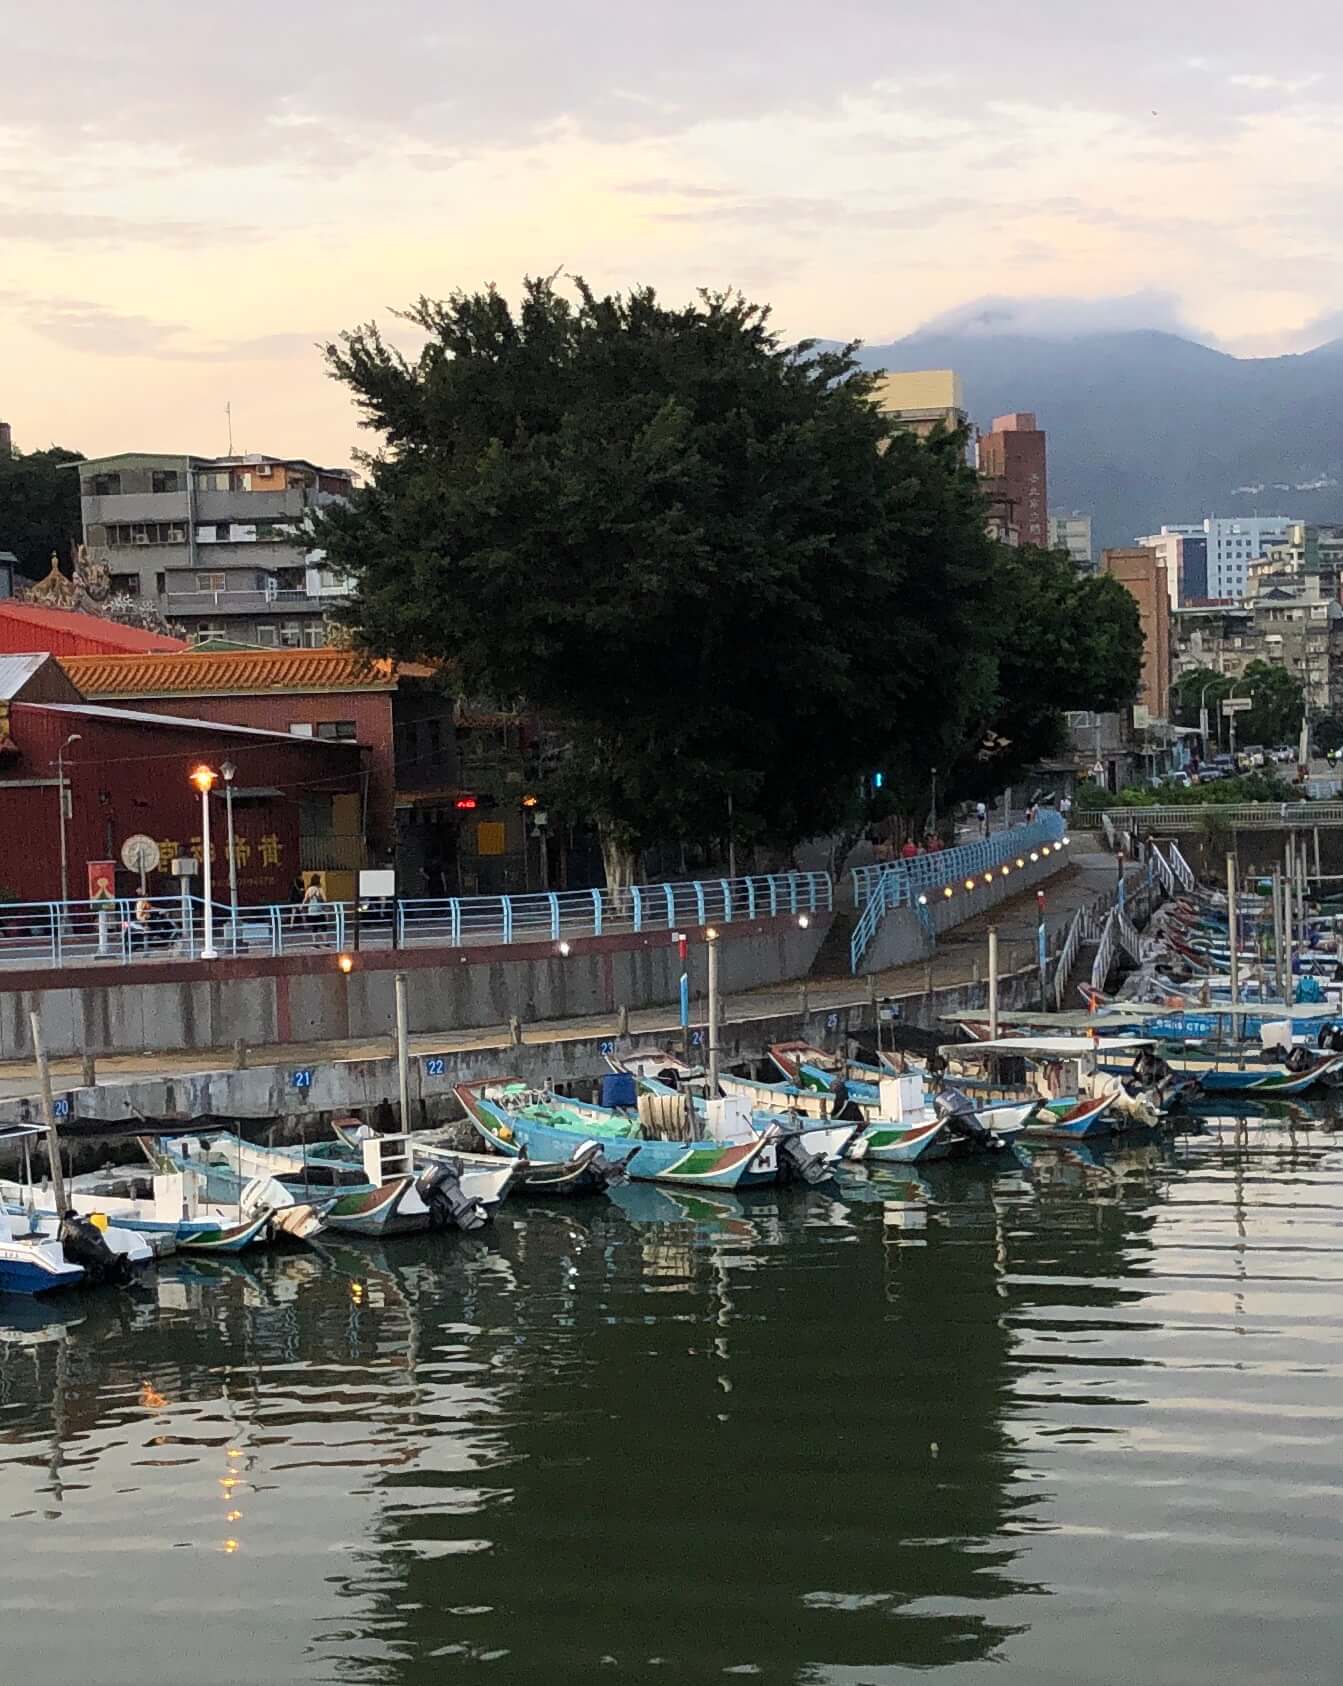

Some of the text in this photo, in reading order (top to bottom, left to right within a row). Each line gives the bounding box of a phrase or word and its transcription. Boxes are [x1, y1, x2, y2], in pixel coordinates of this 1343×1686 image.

[601, 1041, 614, 1056] 23
[428, 1059, 444, 1075] 22
[295, 1071, 310, 1087] 21
[55, 1103, 69, 1116] 20
